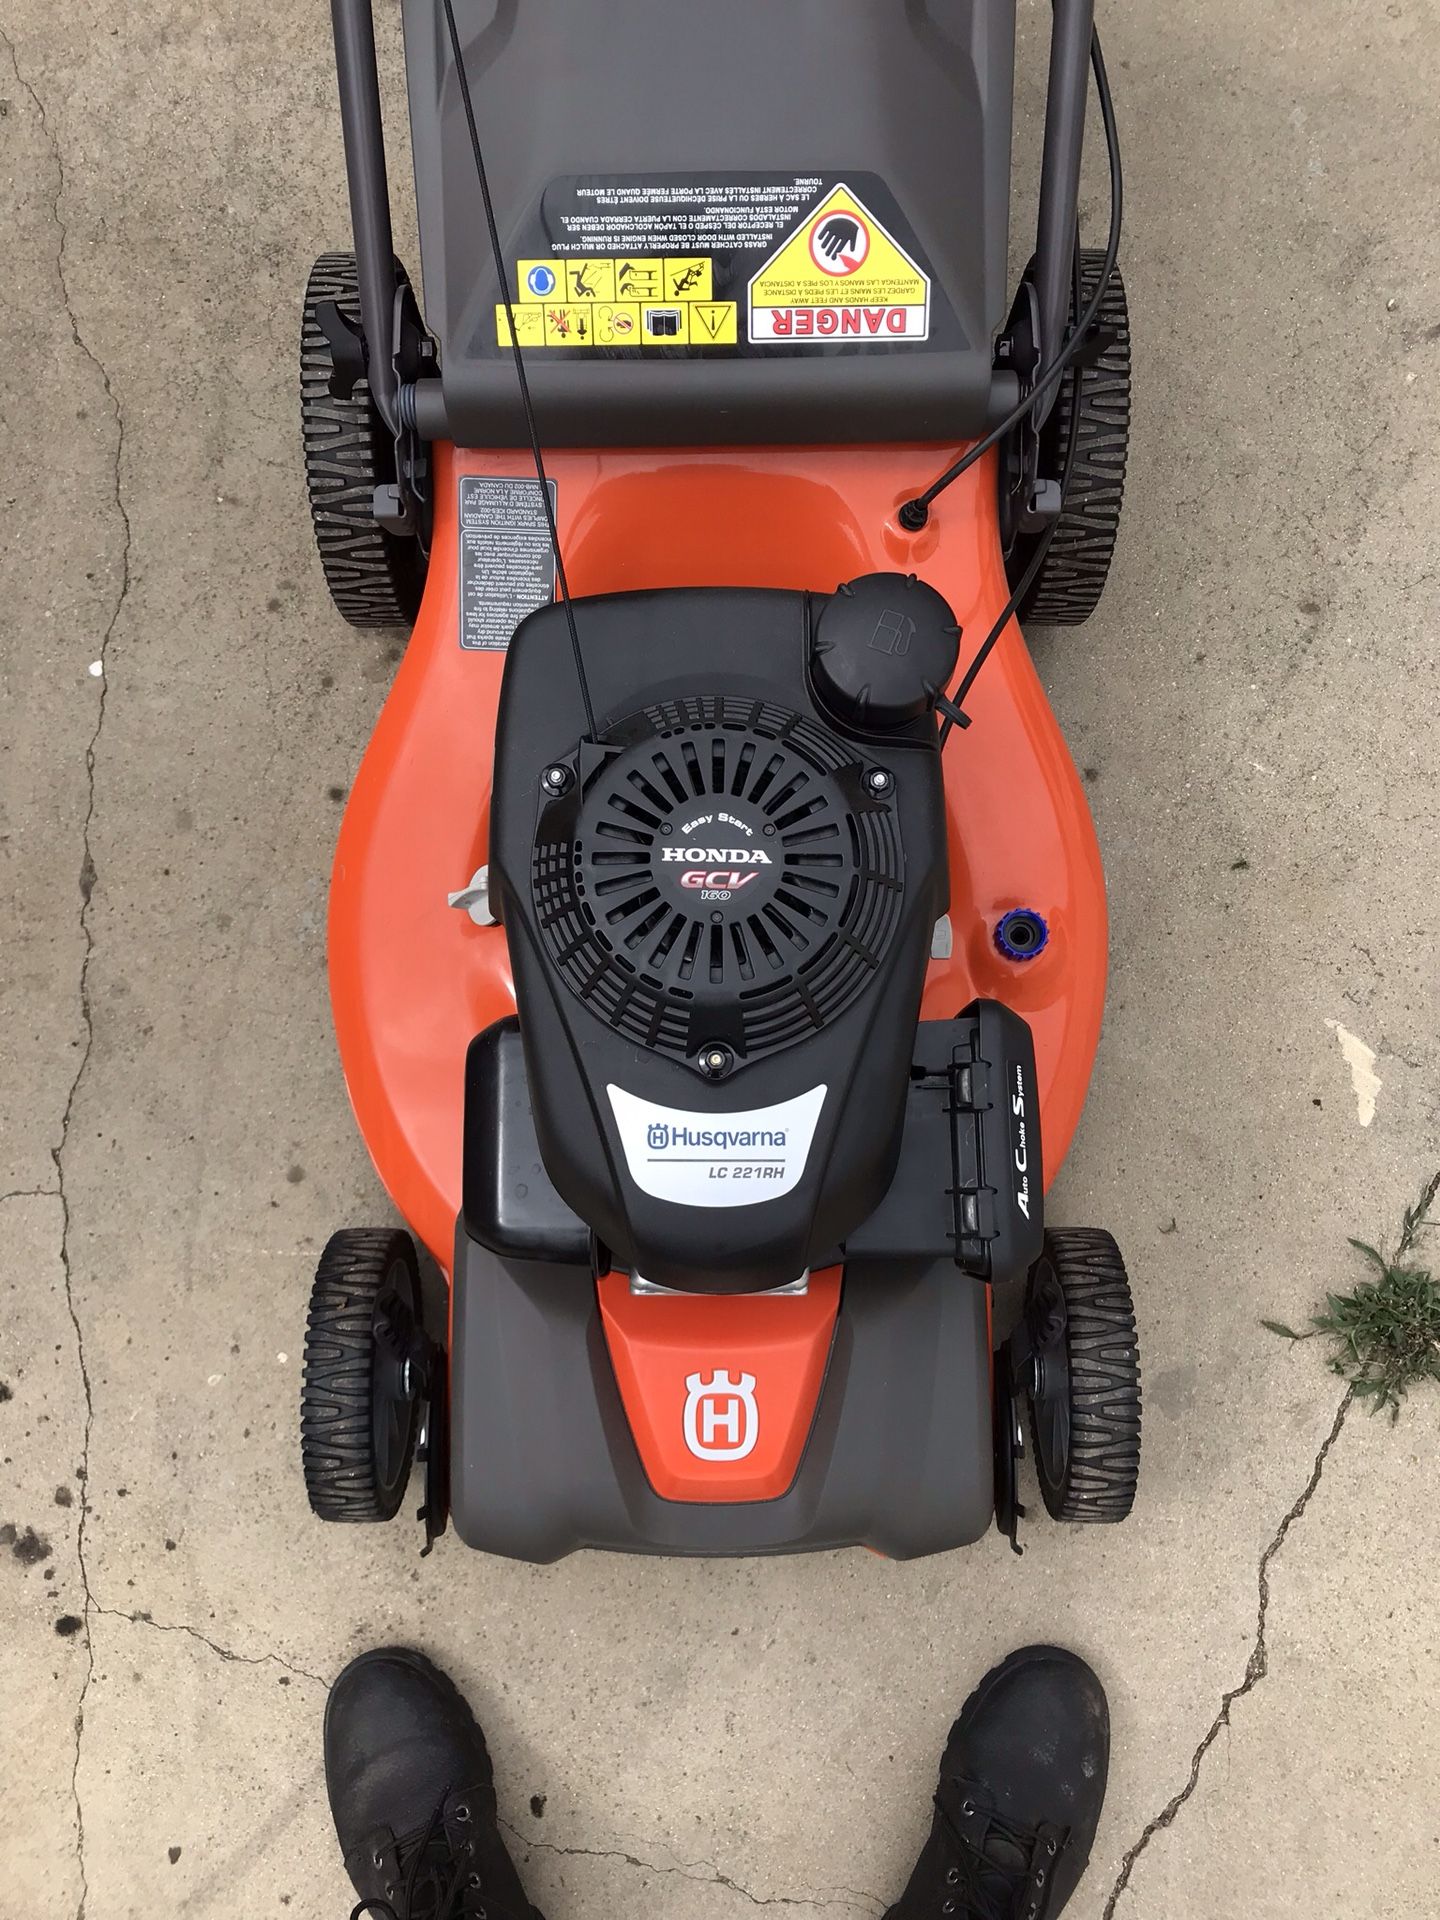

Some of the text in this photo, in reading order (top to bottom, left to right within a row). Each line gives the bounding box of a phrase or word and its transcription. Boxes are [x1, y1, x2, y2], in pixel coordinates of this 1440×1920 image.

[642, 188, 669, 196] FERMÉE
[725, 187, 761, 195] INSTALLÉS
[650, 195, 706, 204] DÉCHIQUETEUSE
[779, 194, 784, 202] À
[755, 206, 773, 214] ESTÁ
[654, 223, 676, 231] TAPÓN
[695, 222, 721, 231] CÉSPED
[771, 308, 906, 335] DANGER
[681, 813, 753, 836] Easy Start
[661, 848, 772, 864] HONDA
[680, 870, 759, 889] GCV
[700, 890, 732, 901] 160
[672, 1127, 786, 1149] Husqvarna
[1012, 1065, 1029, 1219] Auto Choke System
[709, 1167, 785, 1179] LC 221RH
